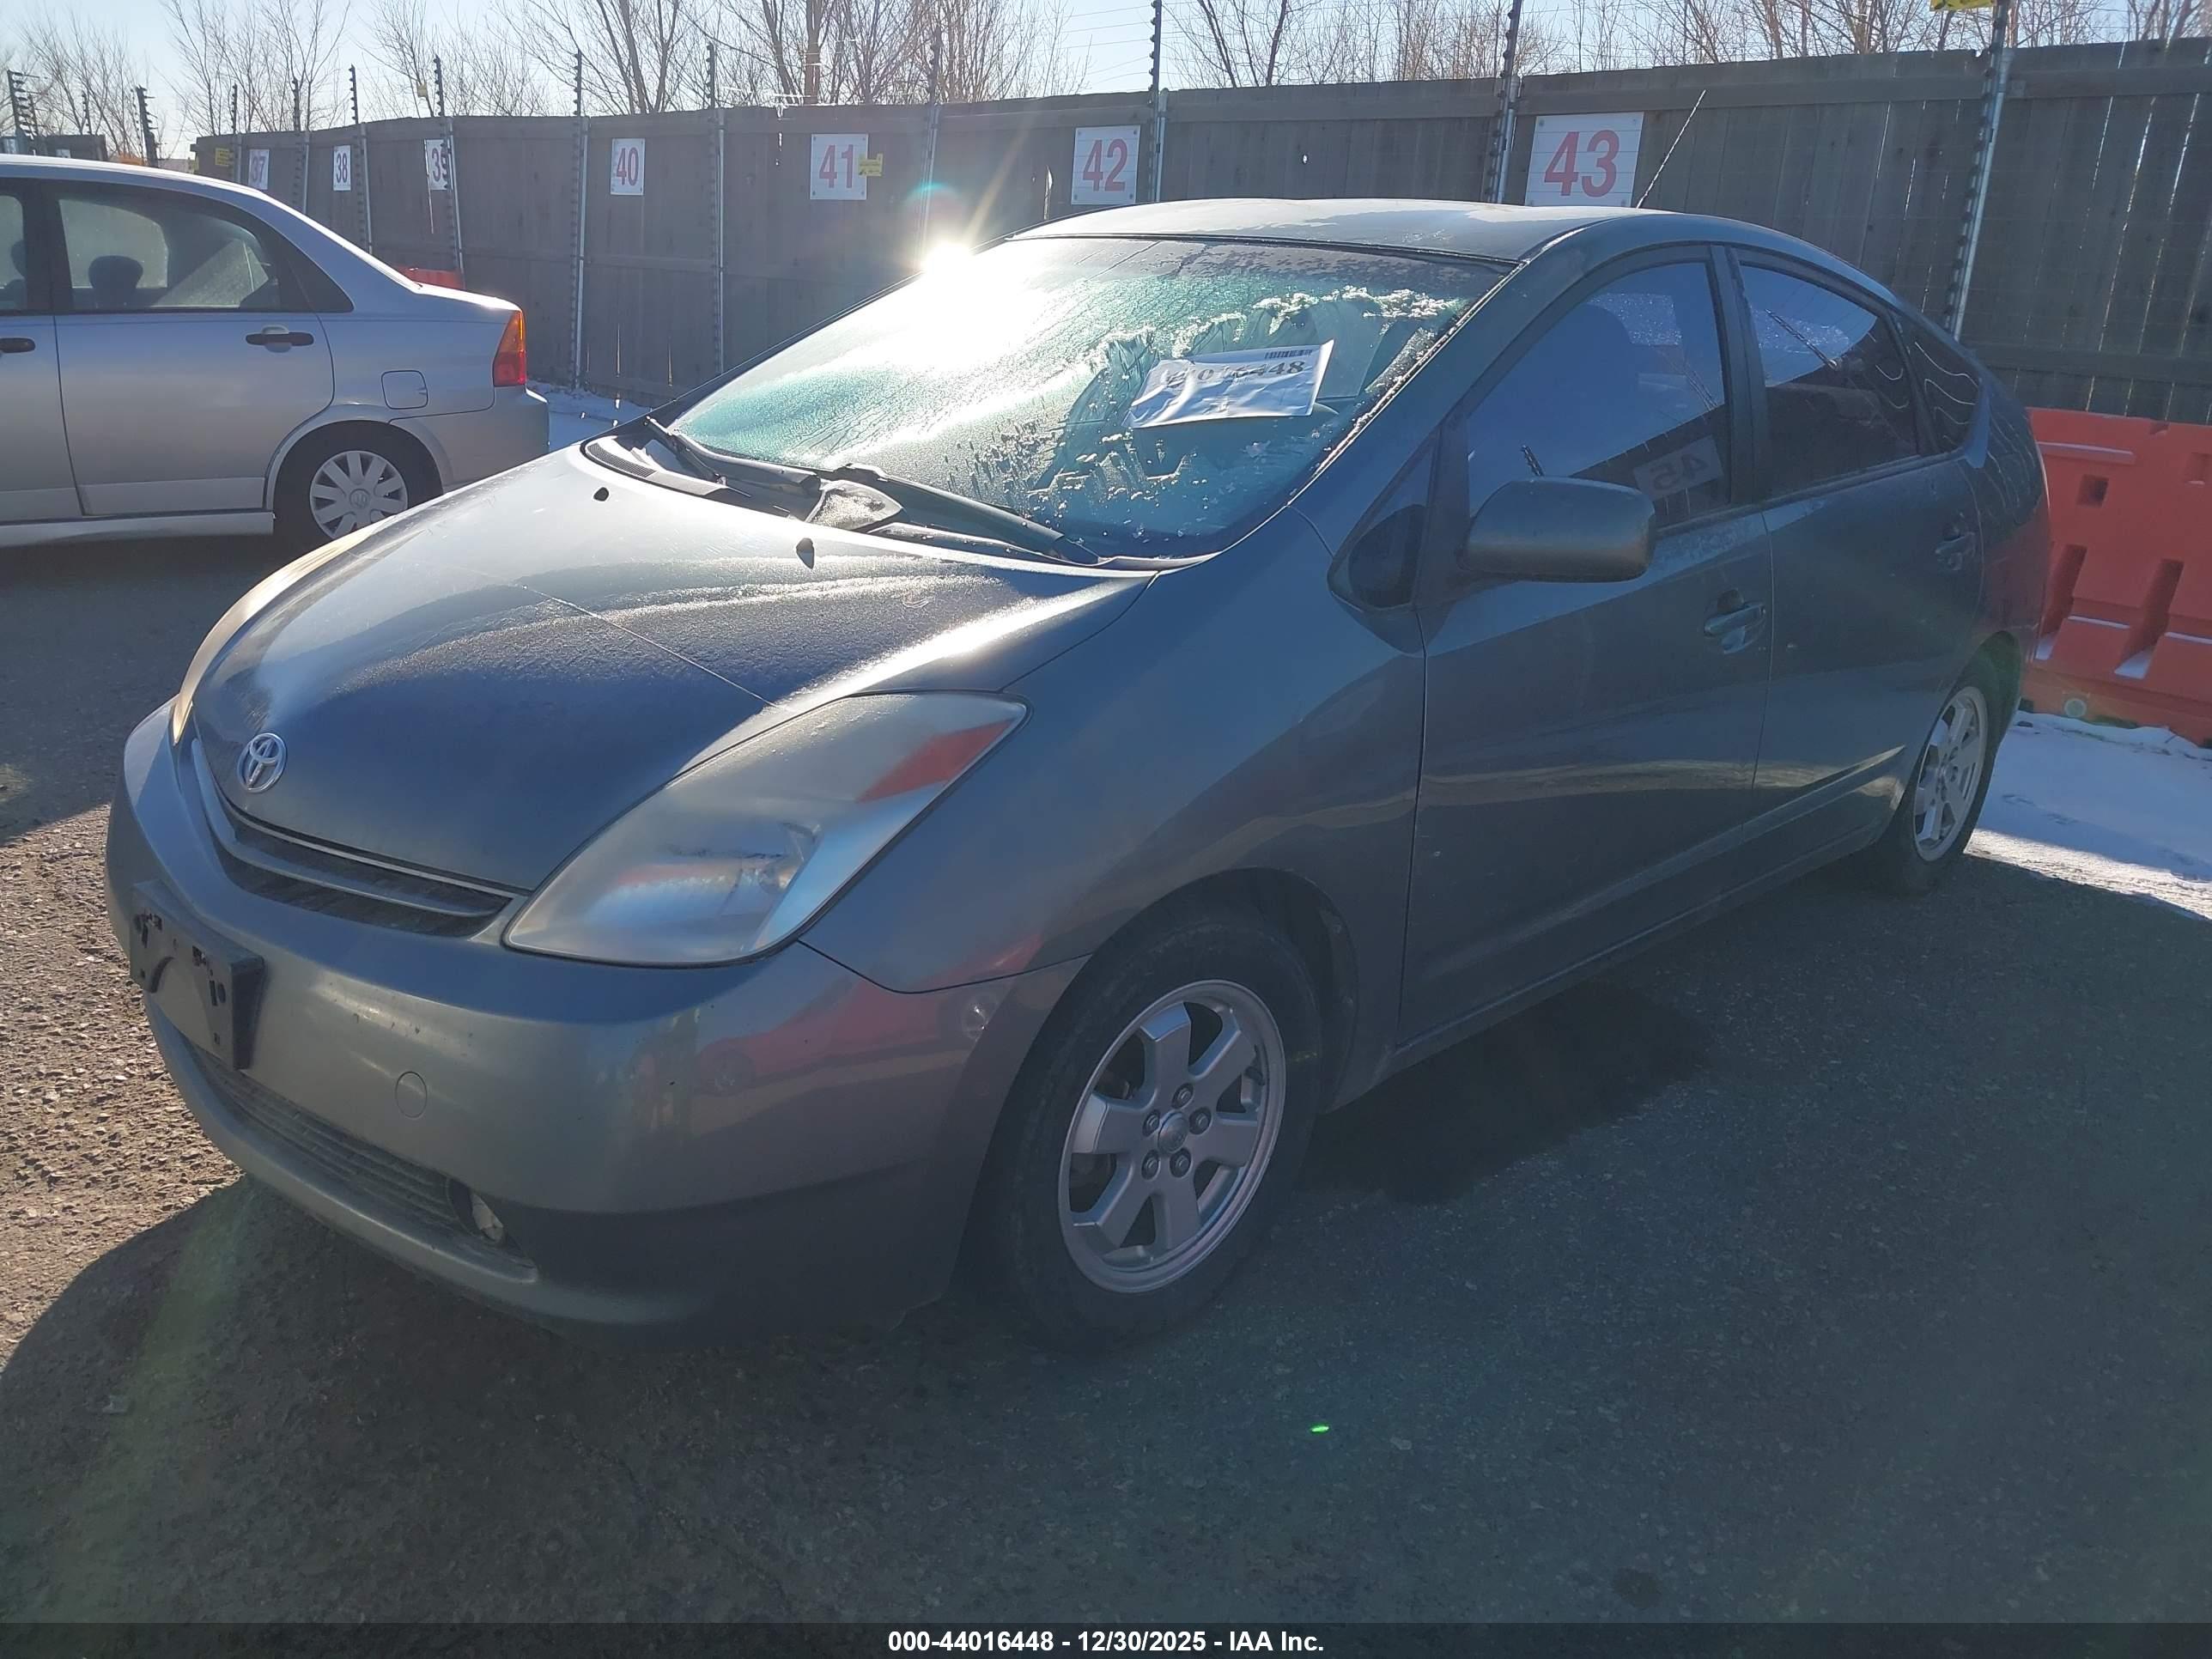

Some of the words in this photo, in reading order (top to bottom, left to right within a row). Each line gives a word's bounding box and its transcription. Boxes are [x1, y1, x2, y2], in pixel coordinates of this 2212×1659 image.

[252, 155, 265, 182] 37
[336, 152, 348, 183] 38
[616, 147, 639, 186] 40
[818, 143, 854, 188] 41
[1083, 138, 1127, 191] 42
[1544, 129, 1620, 198] 43
